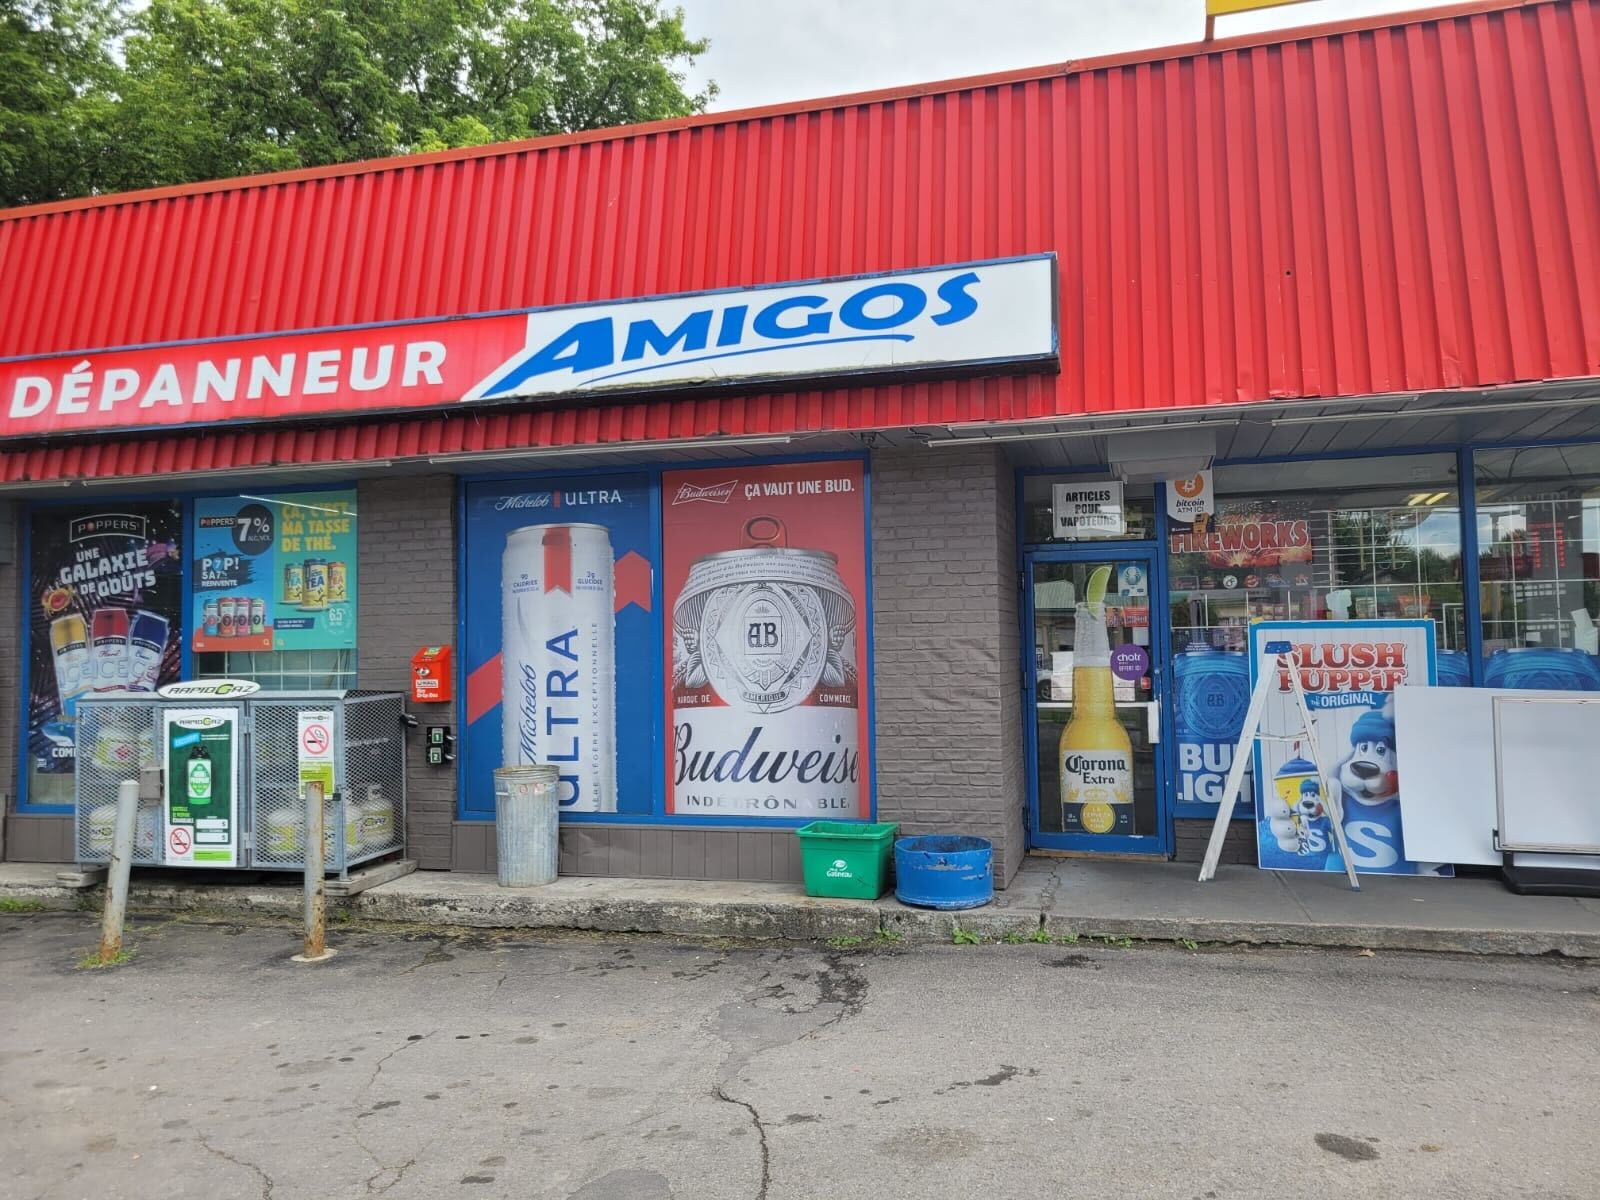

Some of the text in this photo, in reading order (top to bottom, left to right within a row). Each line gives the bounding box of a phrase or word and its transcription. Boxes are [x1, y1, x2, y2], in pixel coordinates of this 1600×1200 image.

[8, 271, 981, 418] DÉPANNEUR AMIGOS
[679, 487, 732, 500] Budweiser
[744, 478, 855, 500] ÇA VAUT UNE BUD.
[1065, 490, 1111, 502] ARTICLES
[494, 490, 622, 511] Michelob ULTRA
[1074, 503, 1101, 514] POUR
[1175, 499, 1205, 508] bitcoin
[78, 520, 137, 534] POPPERS
[282, 518, 350, 535] MA TASSE
[1060, 514, 1117, 528] VAPOTEURS
[282, 534, 336, 552] DE THÉ.
[1171, 520, 1309, 553] FIREWORKS
[76, 548, 100, 562] UNE
[60, 549, 149, 585] GALAXIE
[80, 570, 157, 597] DE GOÛTS
[1117, 653, 1141, 662] chatr
[701, 694, 710, 703] DE
[819, 694, 852, 704] COMMERCE
[1320, 692, 1376, 708] ORIGINAL
[518, 661, 537, 766] Michelob
[546, 628, 580, 807] ULTRA
[1065, 754, 1130, 776] Corona
[1083, 772, 1115, 784] Extra
